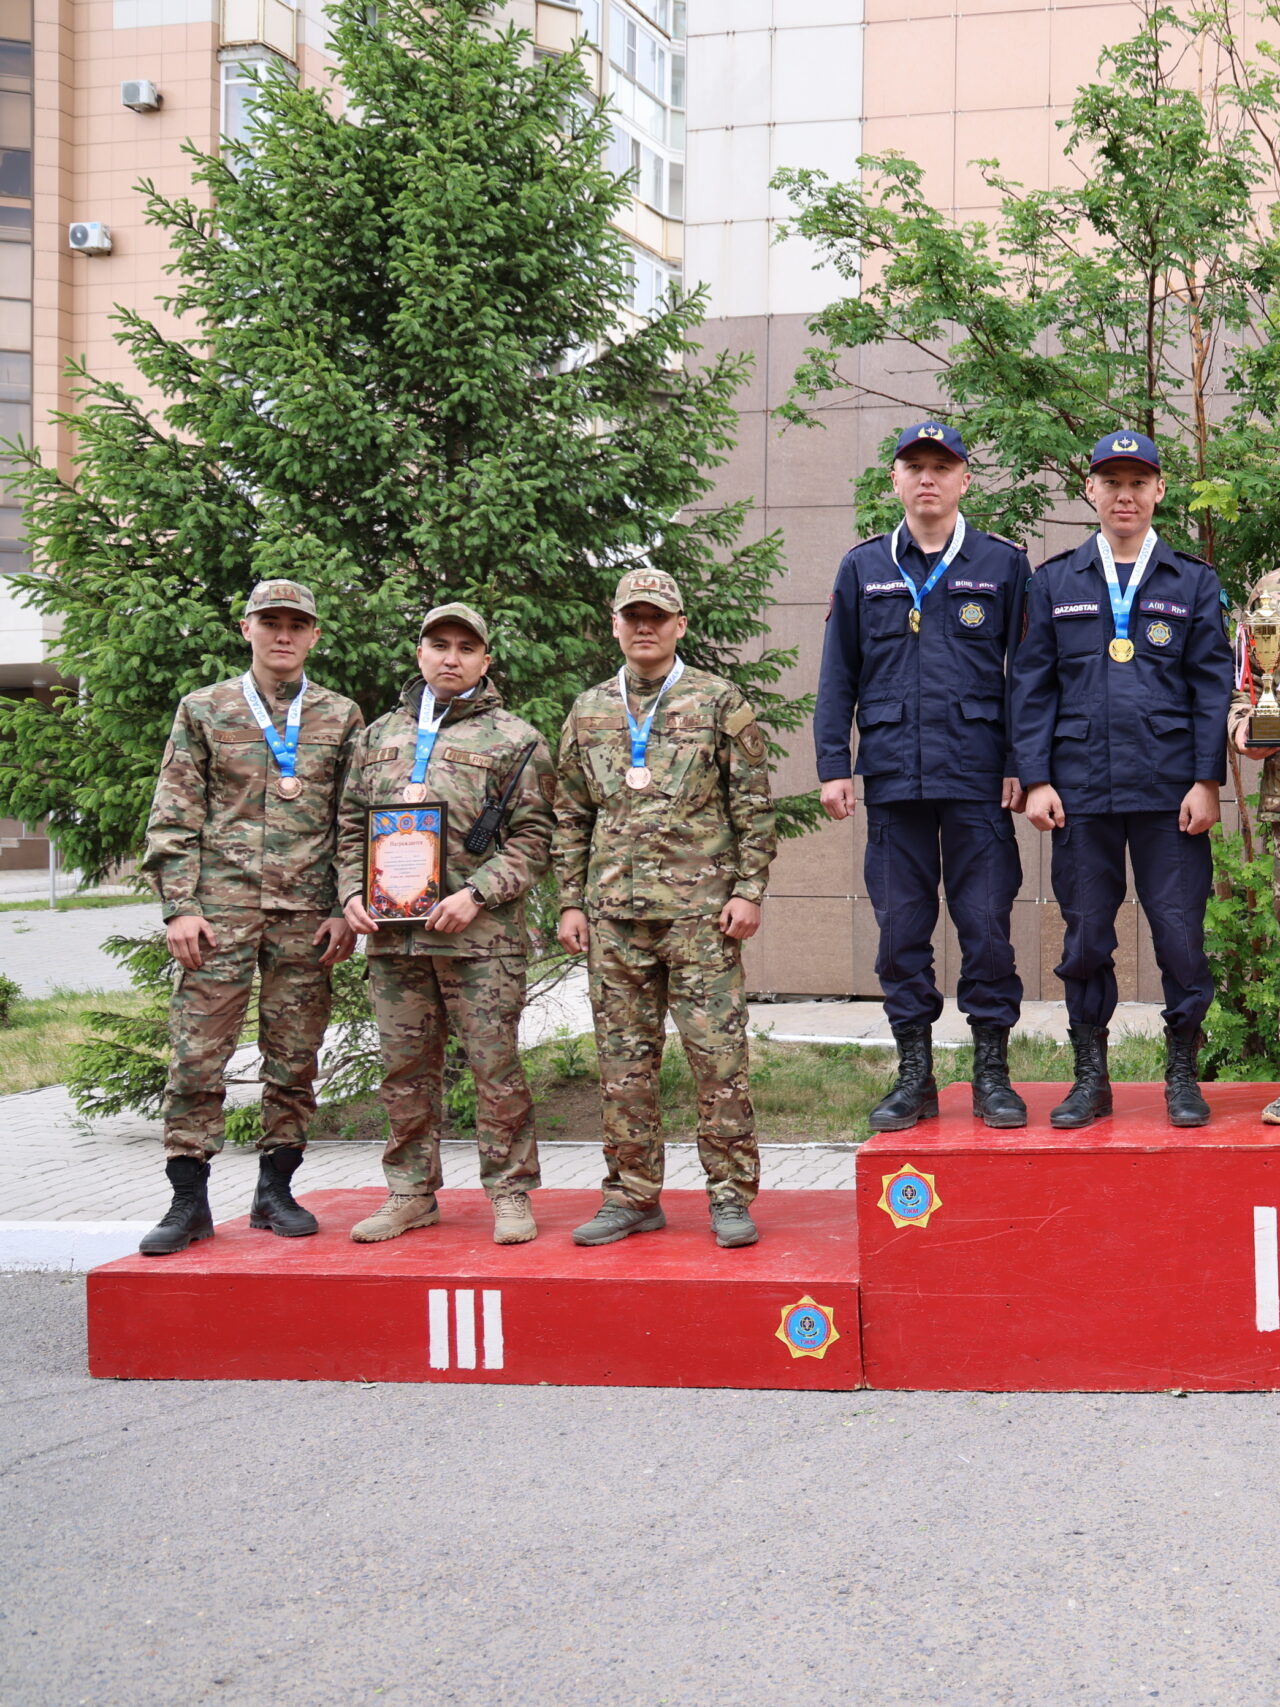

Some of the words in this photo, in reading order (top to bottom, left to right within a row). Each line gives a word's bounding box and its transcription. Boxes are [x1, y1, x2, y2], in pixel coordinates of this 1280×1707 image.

[1054, 604, 1098, 615] QAZAQSTAN
[1147, 602, 1165, 611] A(II)
[1171, 605, 1187, 614] Rh+
[1253, 1205, 1280, 1333] I
[428, 1288, 504, 1371] III
